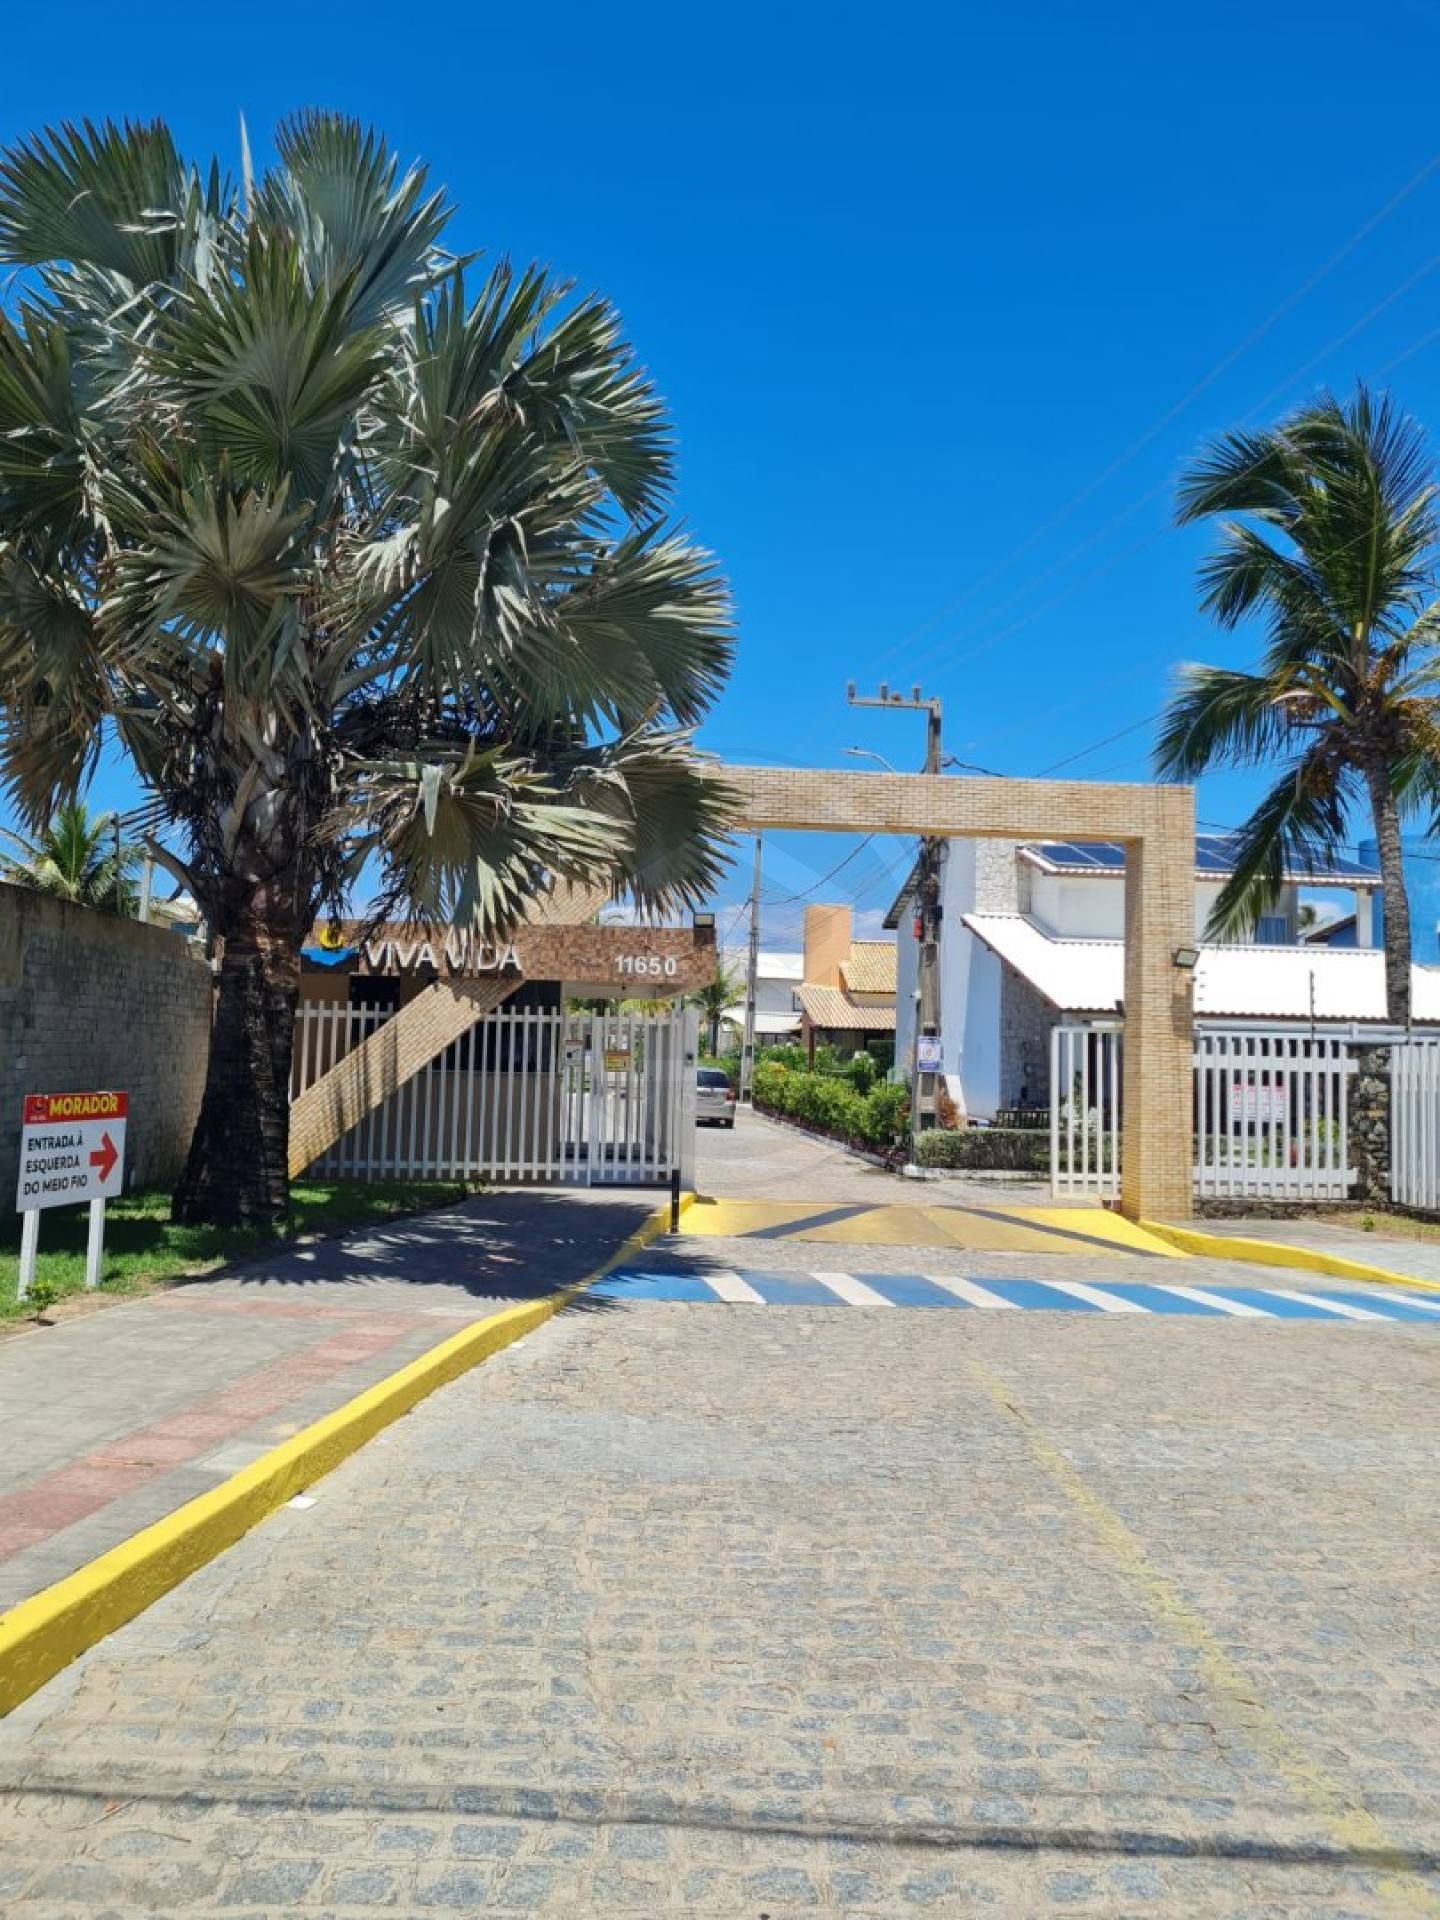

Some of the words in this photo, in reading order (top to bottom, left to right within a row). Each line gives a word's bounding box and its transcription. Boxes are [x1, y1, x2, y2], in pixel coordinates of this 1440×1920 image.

[365, 940, 440, 969] VIVA
[446, 938, 524, 971] VIDA
[614, 954, 677, 976] 11650
[50, 1096, 118, 1116] MORADOR
[28, 1135, 75, 1152] ENTRADA
[26, 1155, 80, 1174] ESQUERDA
[24, 1181, 40, 1196] DO
[43, 1176, 69, 1193] MEIO
[71, 1174, 88, 1188] FIO
